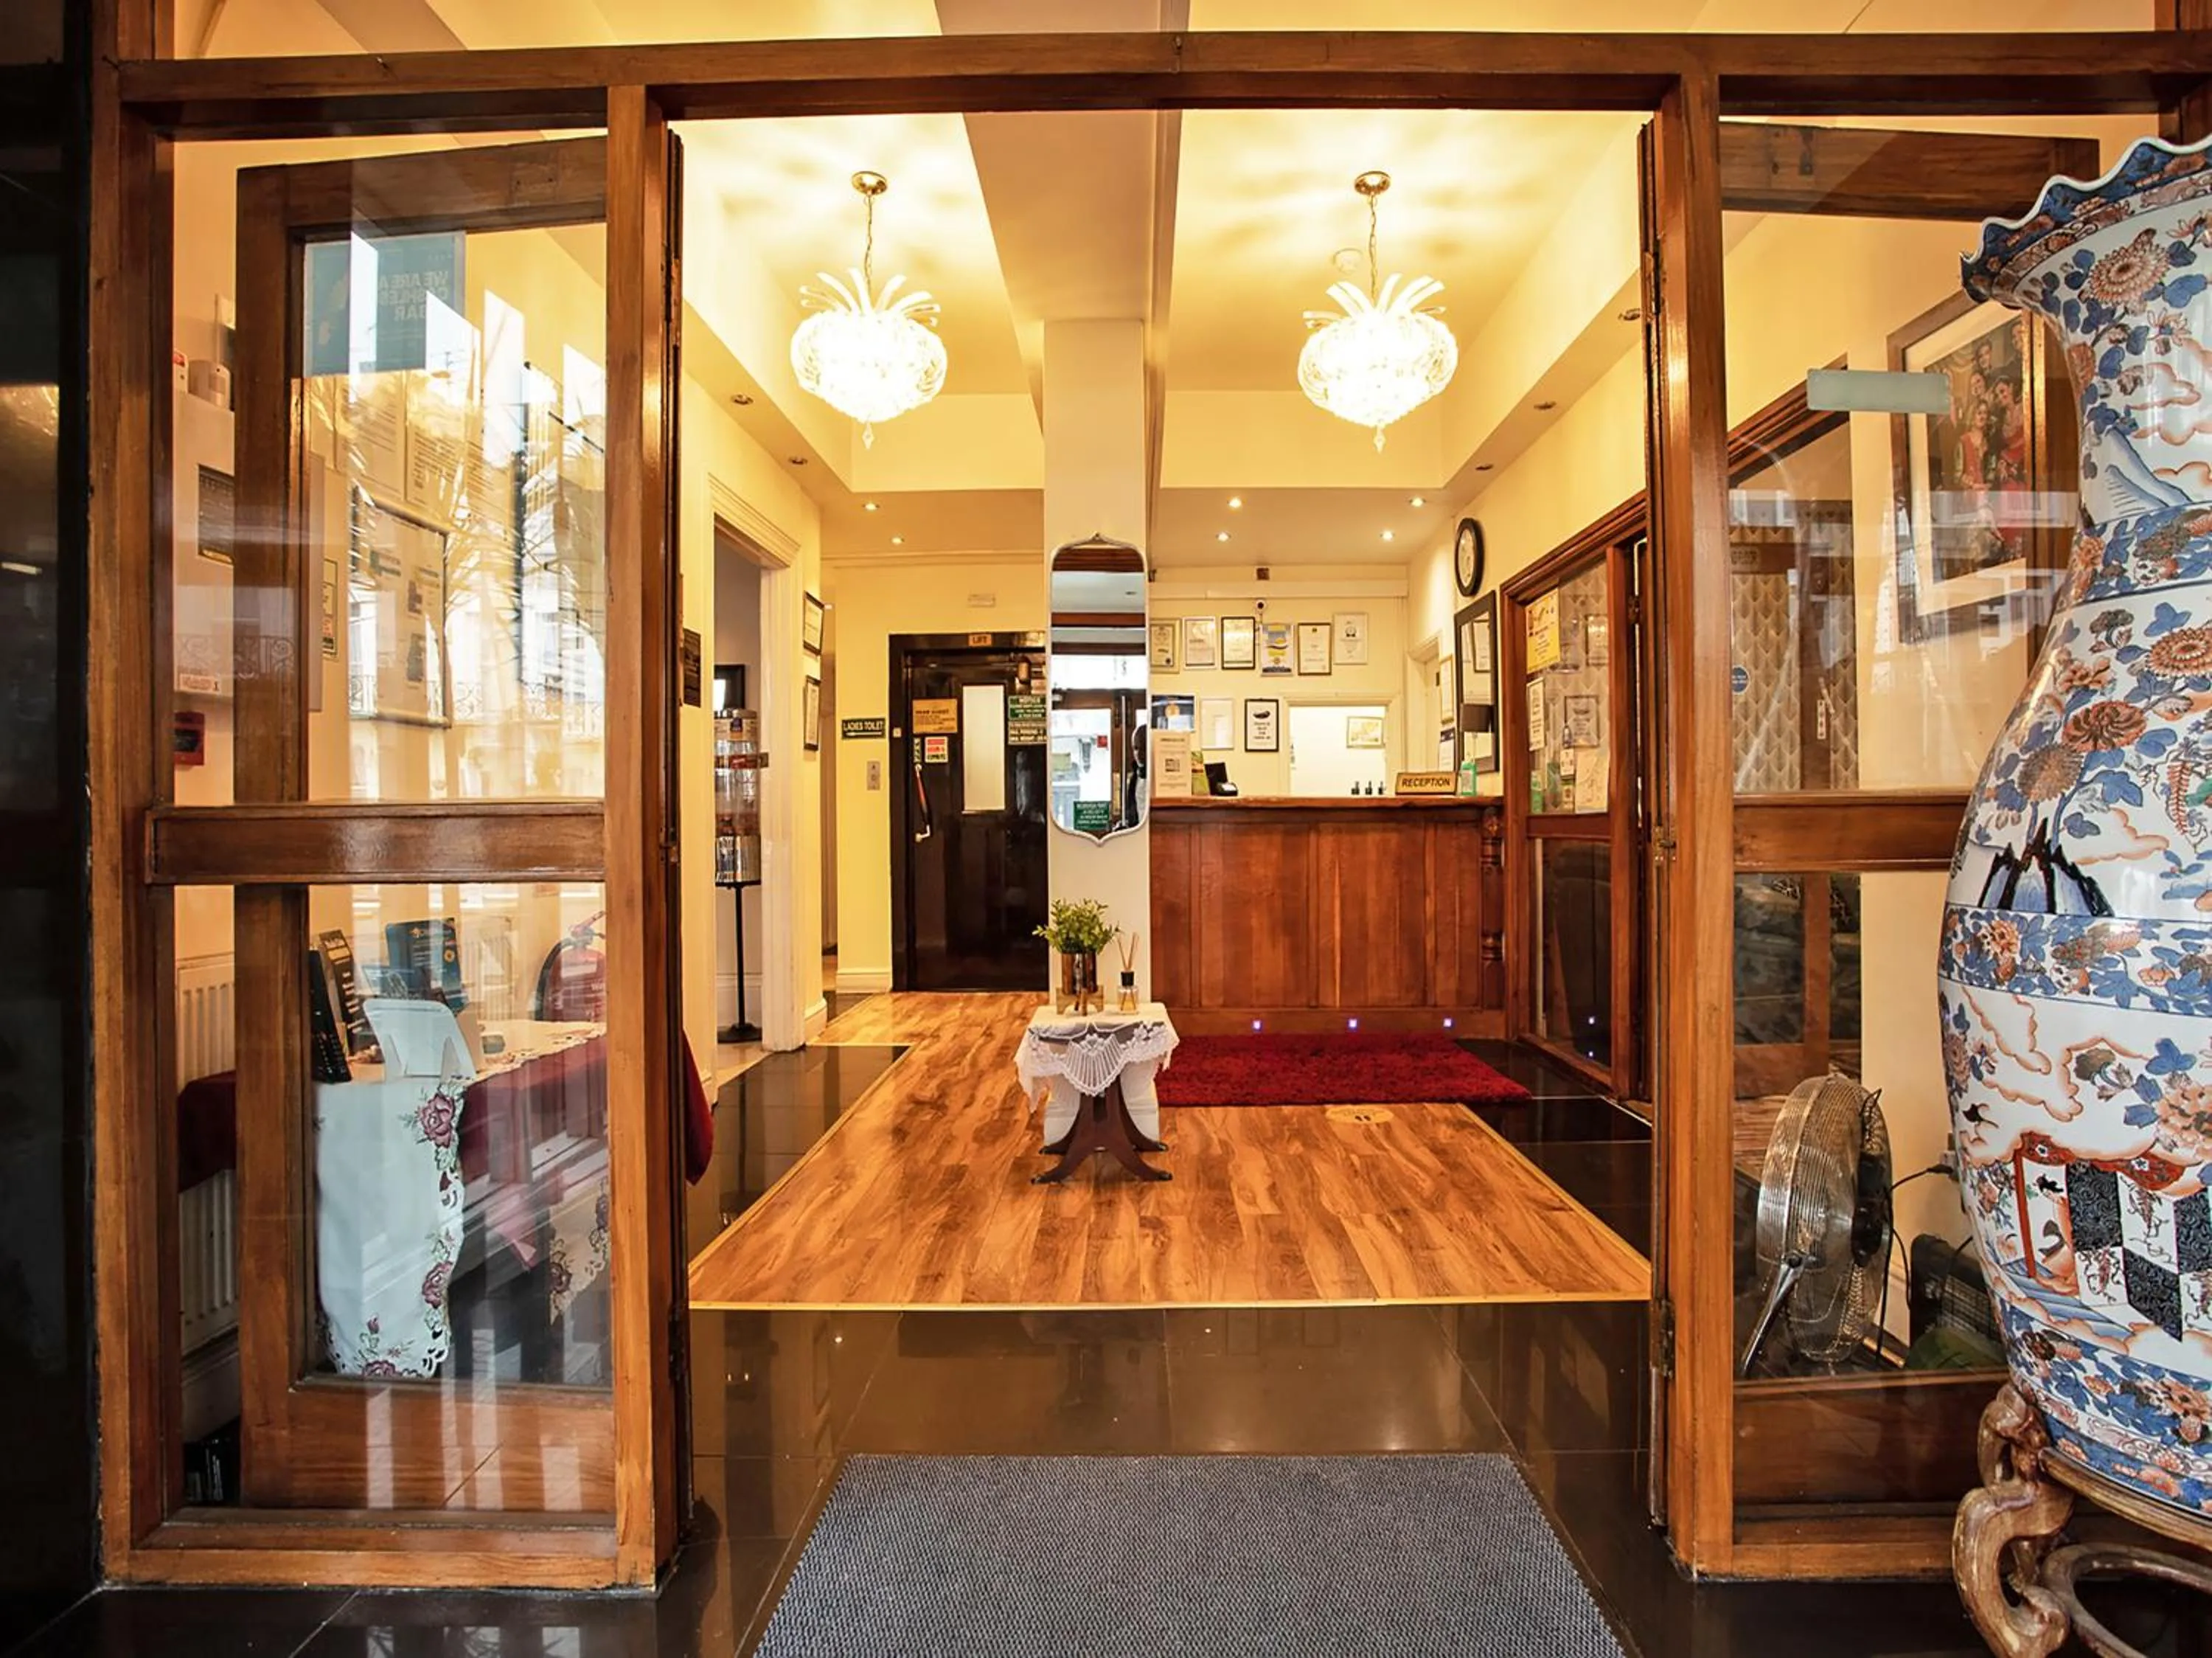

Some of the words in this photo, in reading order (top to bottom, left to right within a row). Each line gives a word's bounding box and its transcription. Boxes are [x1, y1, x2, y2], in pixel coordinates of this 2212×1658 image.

[973, 636, 987, 644] LIFT
[843, 721, 863, 731] LADIES
[863, 720, 883, 730] TOILET
[1402, 778, 1450, 787] RECEPTION
